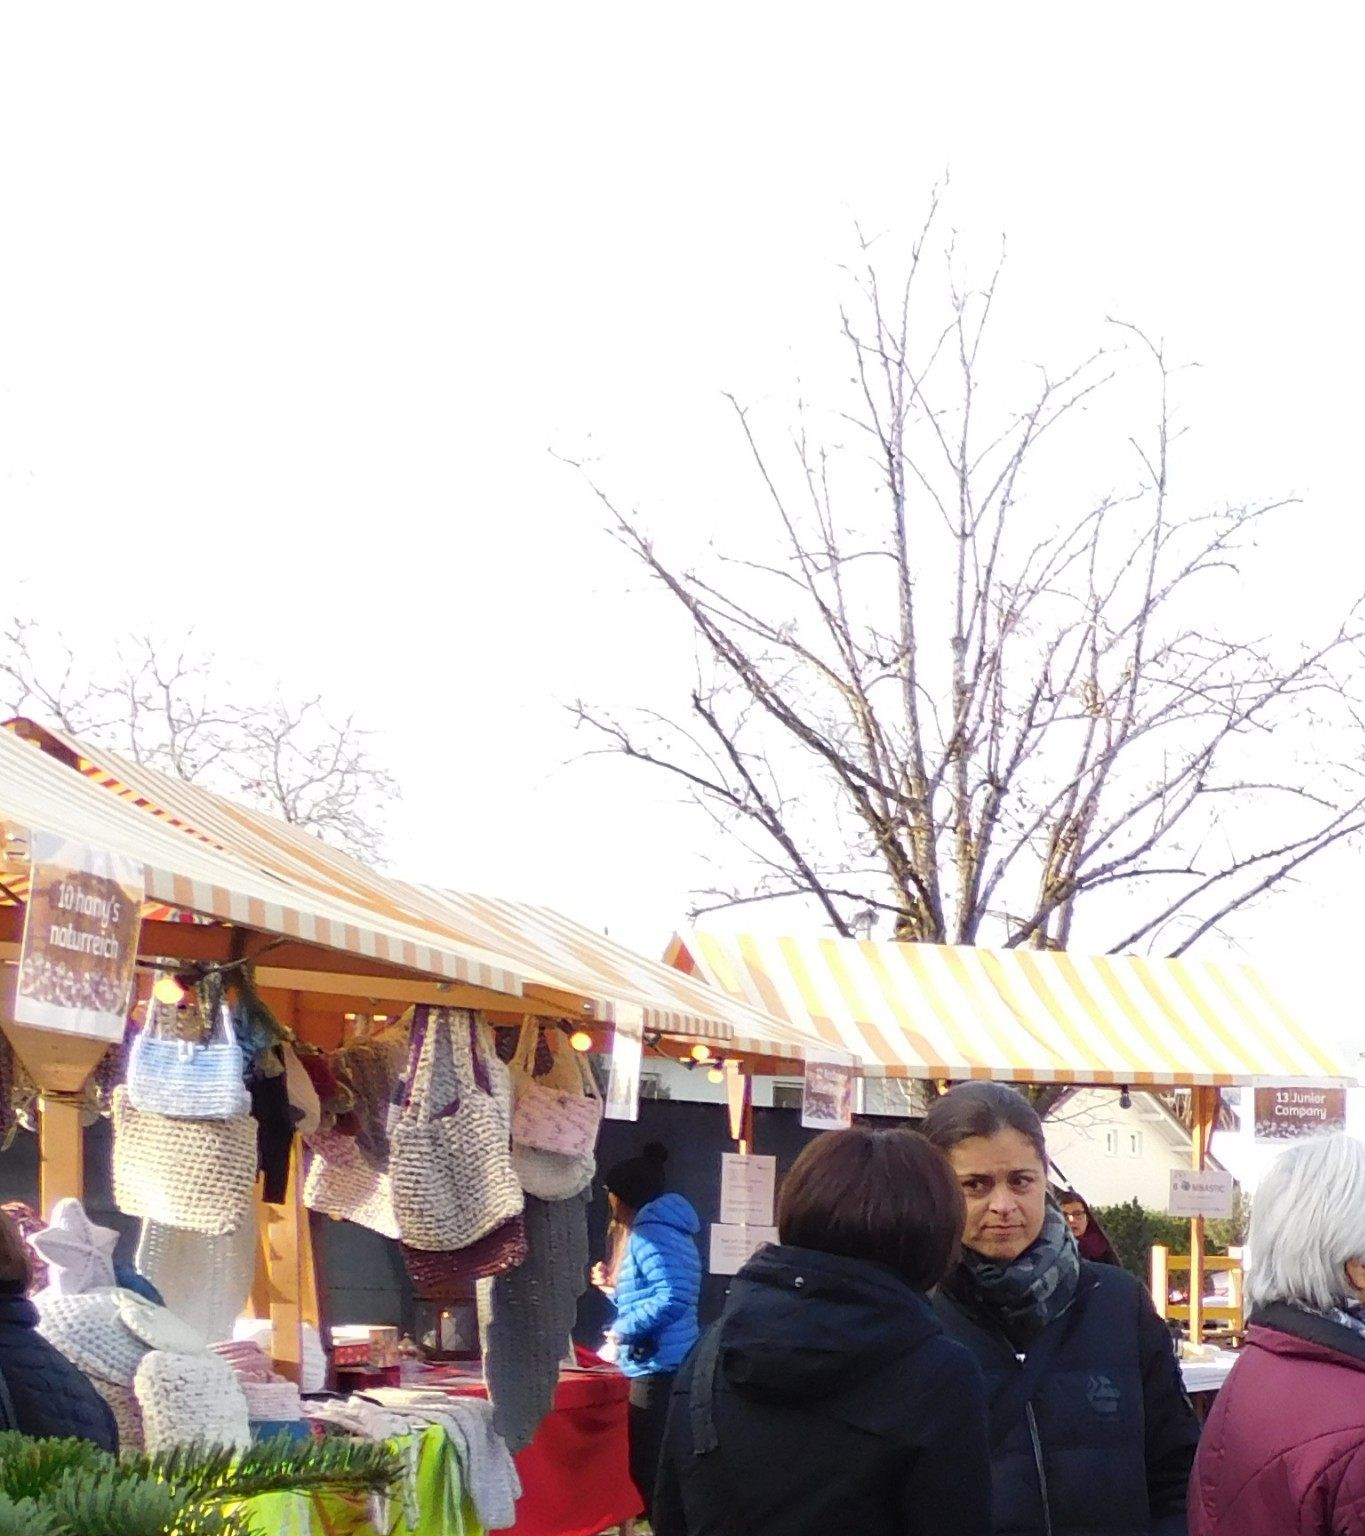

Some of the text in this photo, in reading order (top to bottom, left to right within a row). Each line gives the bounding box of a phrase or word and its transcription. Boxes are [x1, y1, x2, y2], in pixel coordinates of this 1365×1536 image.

[58, 882, 75, 911] 10
[50, 922, 120, 960] naturreich
[1276, 1092, 1327, 1105] 13 Junior
[1275, 1105, 1327, 1120] Company
